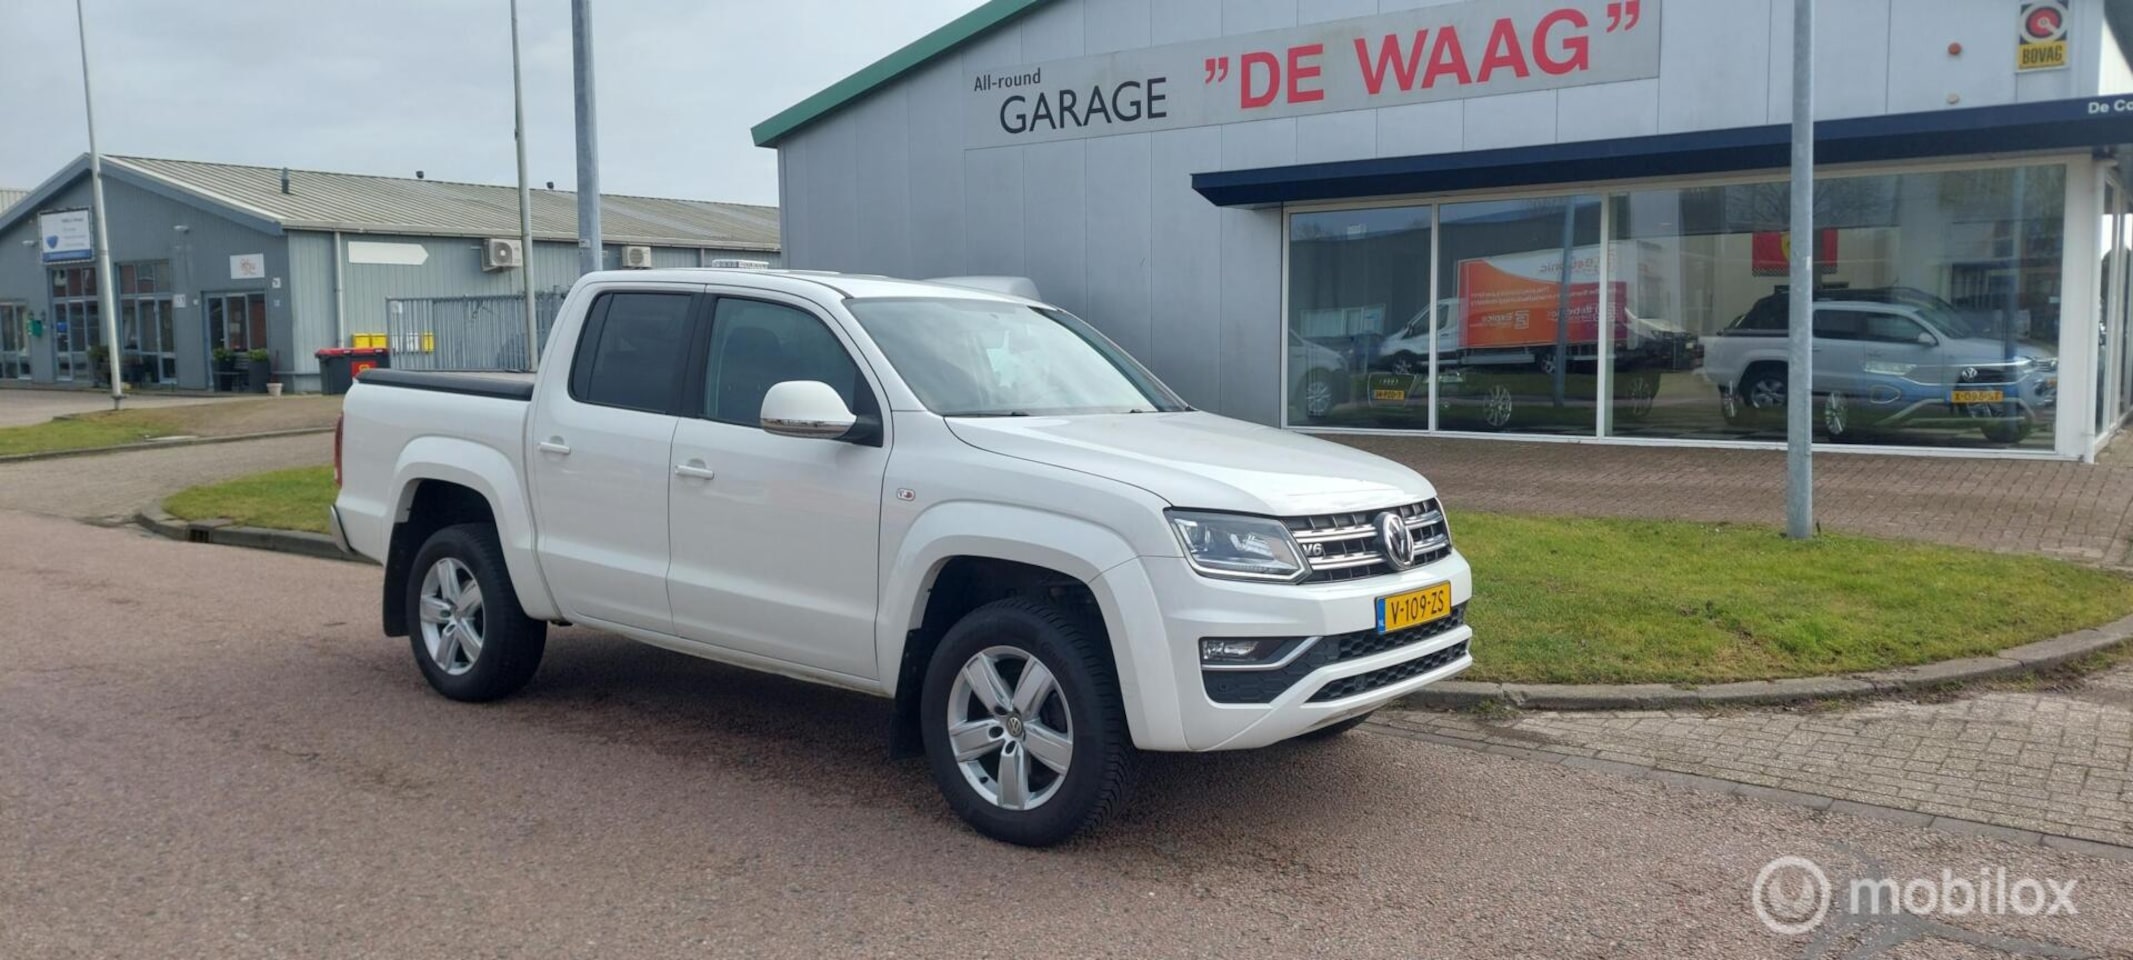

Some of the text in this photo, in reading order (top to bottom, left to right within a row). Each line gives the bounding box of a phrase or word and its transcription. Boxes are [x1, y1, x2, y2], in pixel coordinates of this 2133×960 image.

[2022, 45, 2063, 64] BOVAG
[974, 67, 1041, 92] All-round
[1000, 77, 1167, 134] GARAGE
[2088, 102, 2109, 114] De
[1302, 543, 1322, 557] V6
[1391, 590, 1444, 625] V-109-ZS
